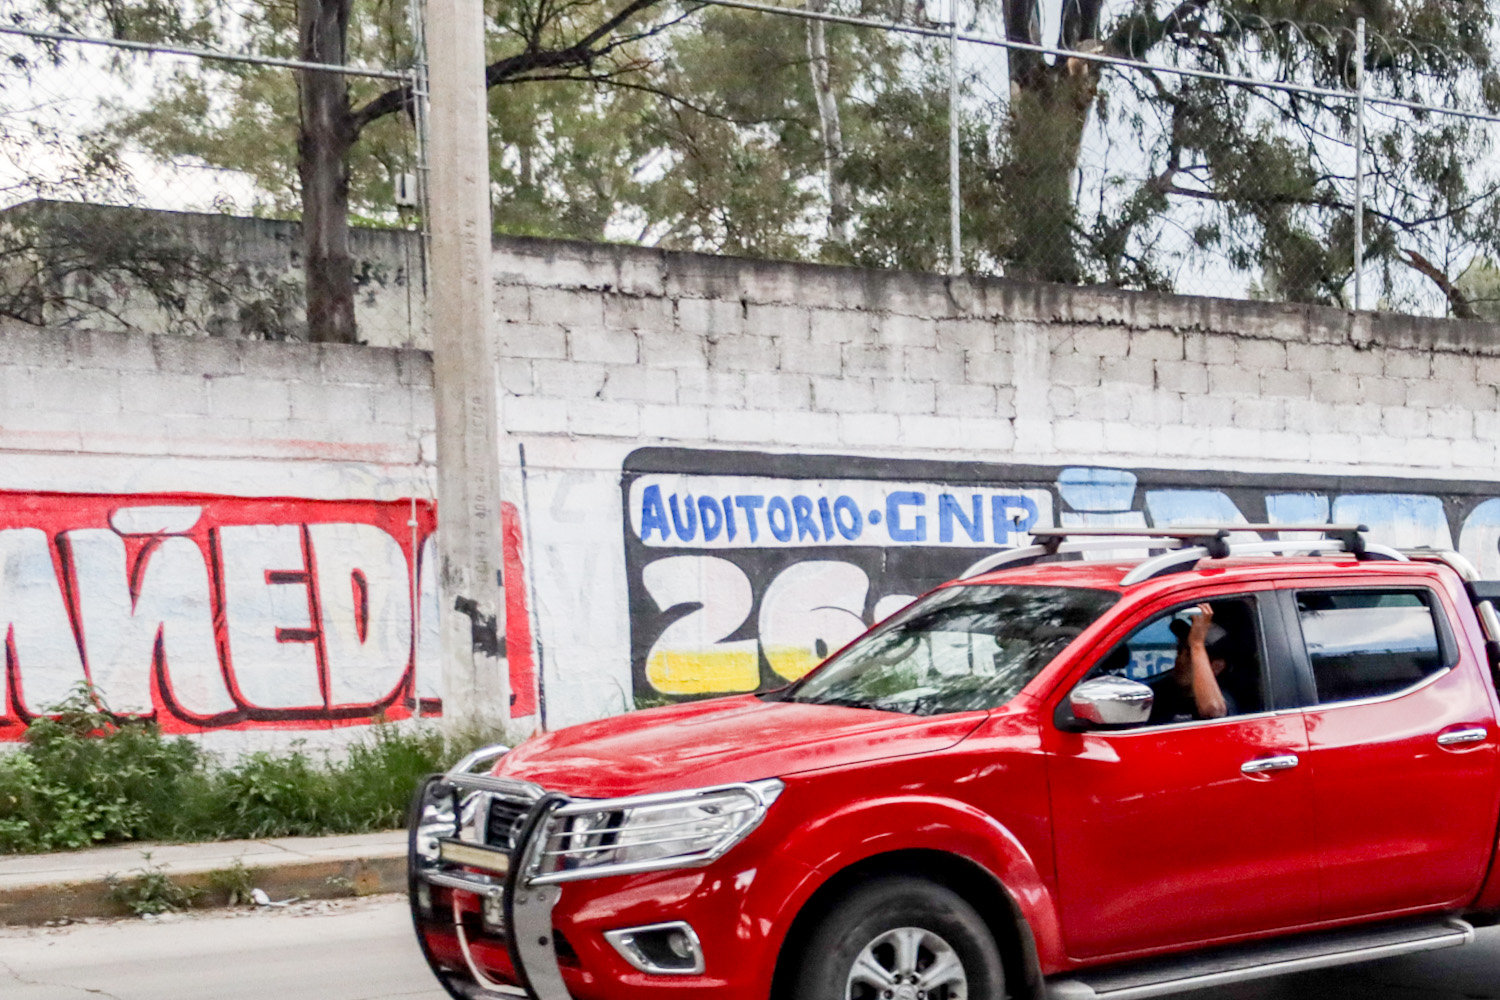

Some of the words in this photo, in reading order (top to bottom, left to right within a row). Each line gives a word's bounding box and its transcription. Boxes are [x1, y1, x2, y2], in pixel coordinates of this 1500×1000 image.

[641, 483, 863, 543] AUDITORIO
[886, 490, 1039, 545] GNP
[642, 555, 870, 694] 26
